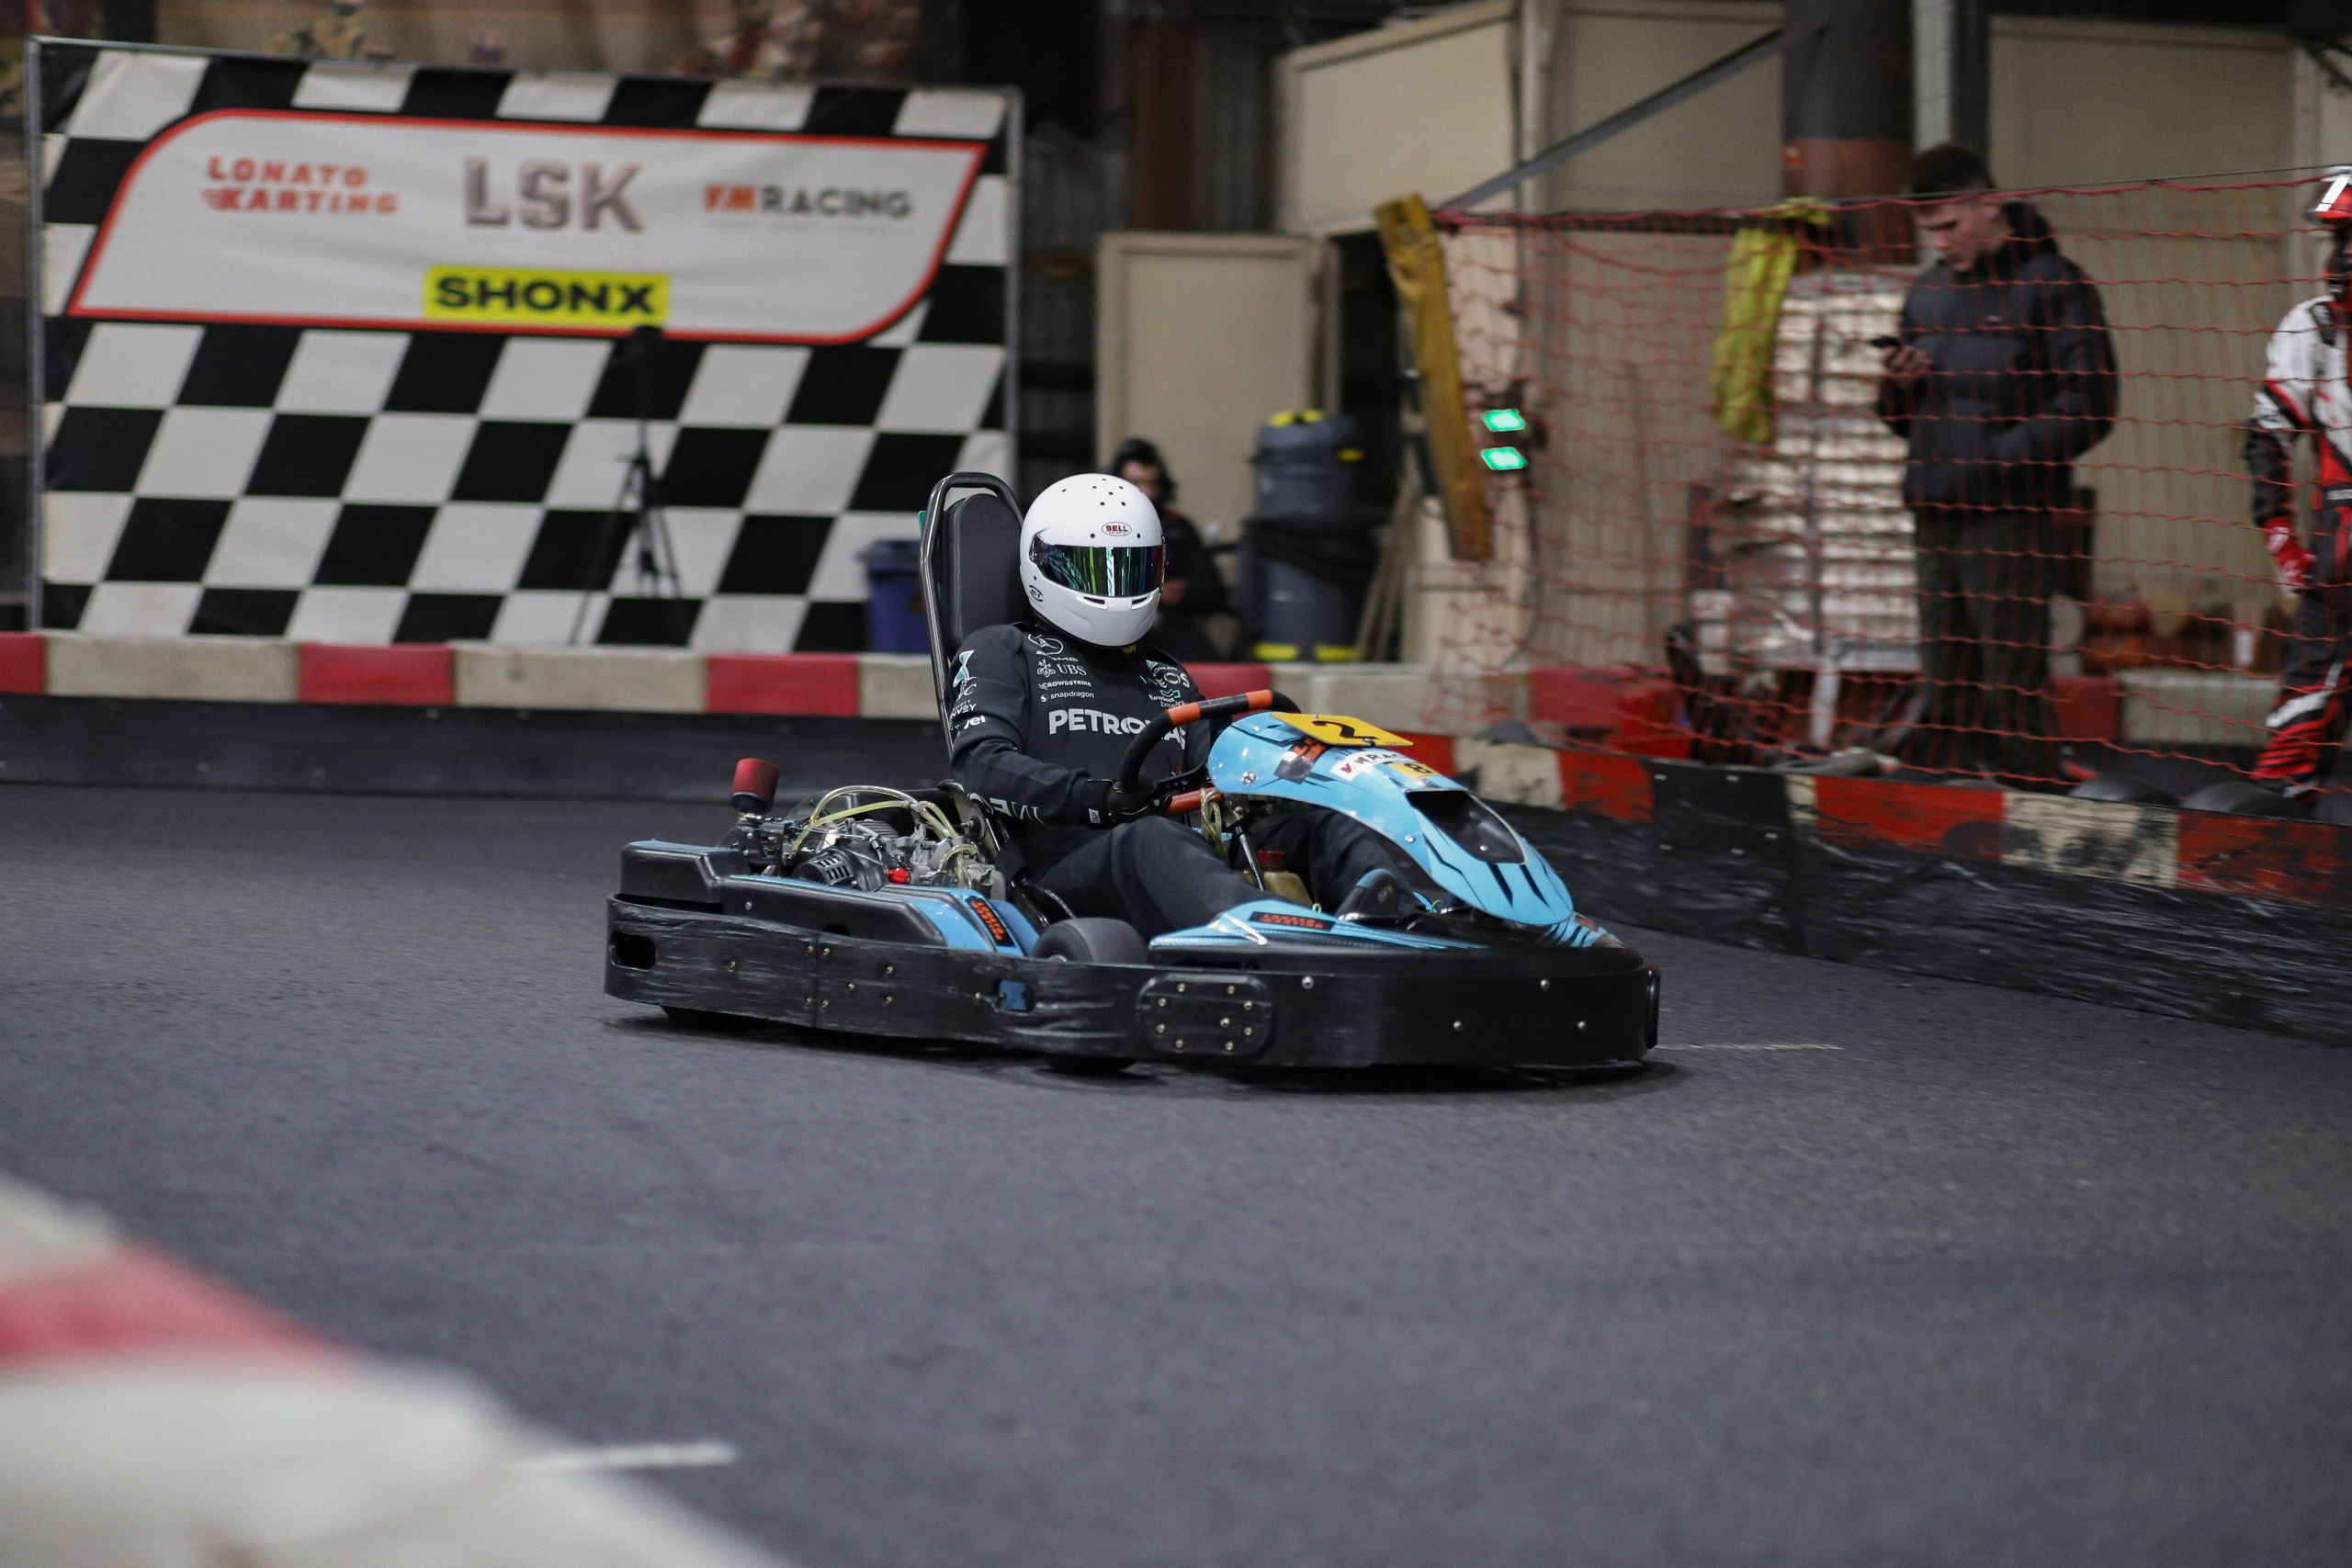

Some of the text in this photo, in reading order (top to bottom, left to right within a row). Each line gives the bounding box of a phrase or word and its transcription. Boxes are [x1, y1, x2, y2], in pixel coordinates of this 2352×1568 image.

[208, 155, 367, 187] LONATO
[202, 188, 399, 214] KARTING
[464, 155, 645, 234] LSK
[436, 276, 656, 315] SHONX
[1105, 525, 1128, 533] BELL
[1057, 663, 1087, 676] UBS
[1042, 680, 1092, 688] CROWDSTRIKE
[1050, 690, 1095, 700] snapdragon
[1048, 708, 1187, 750] PETROAS
[1312, 720, 1380, 739] 2
